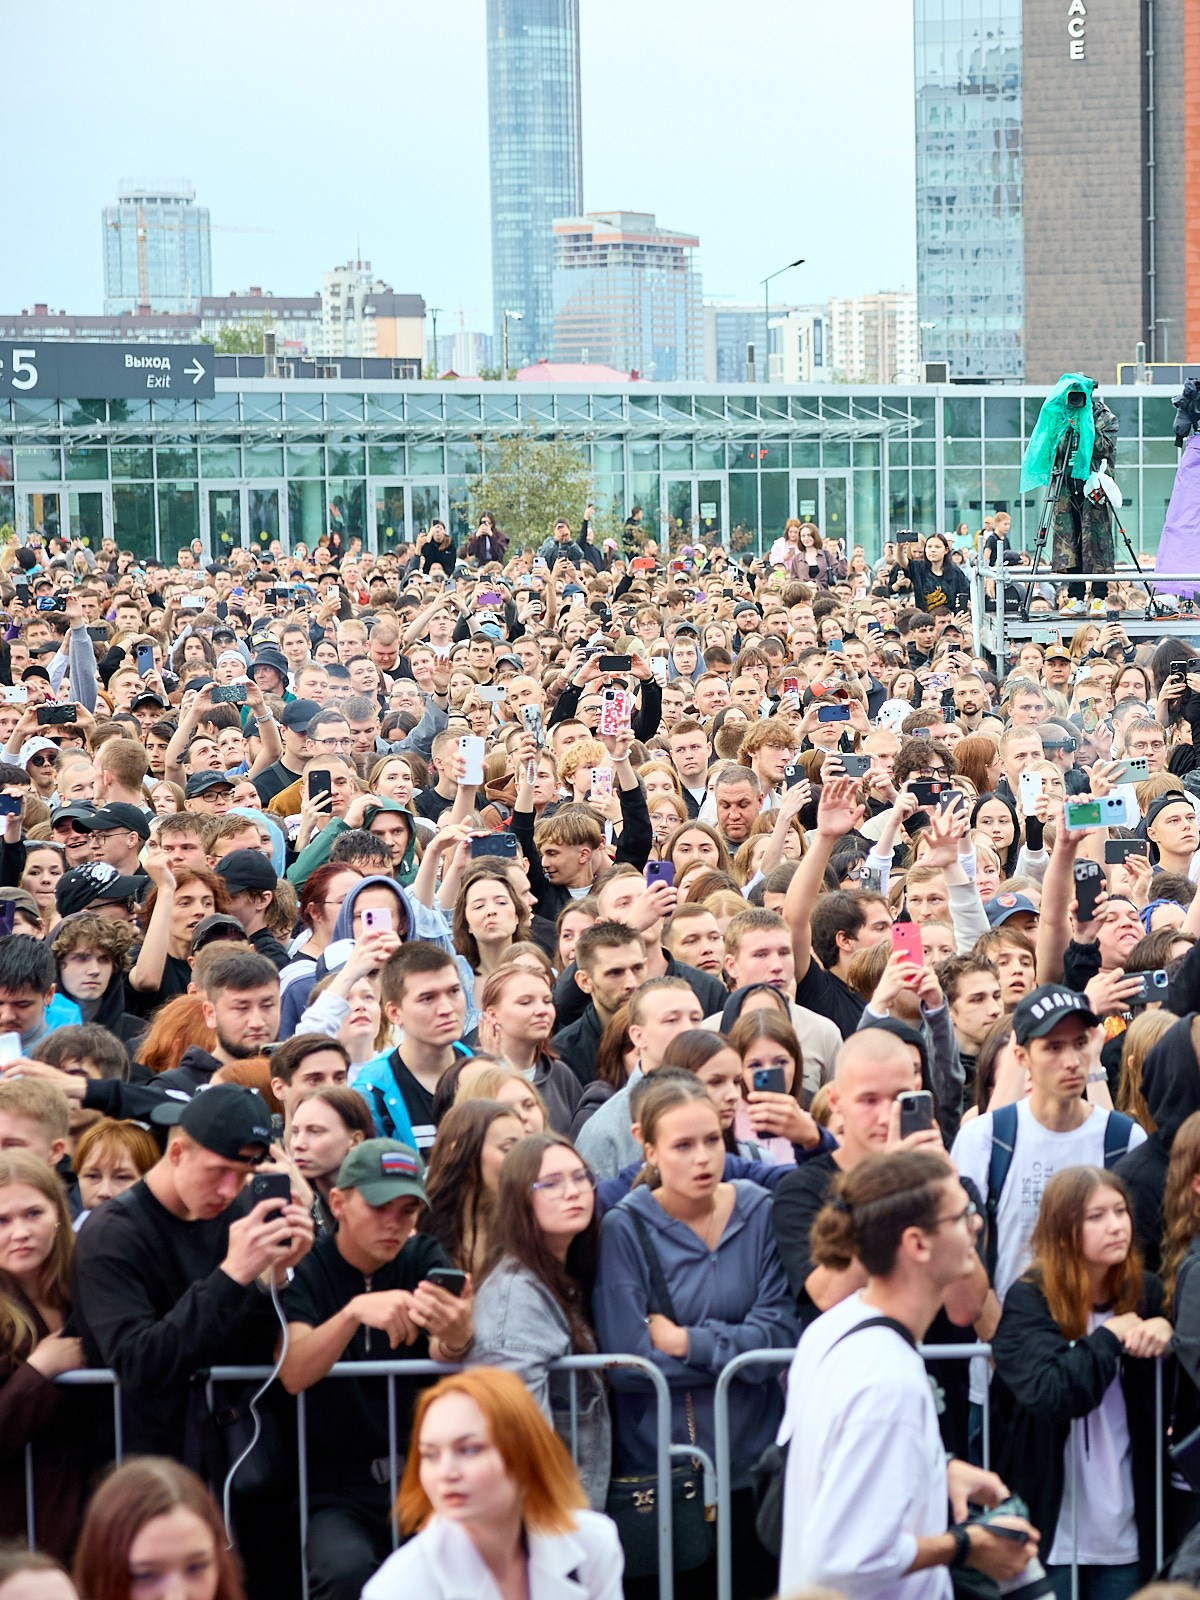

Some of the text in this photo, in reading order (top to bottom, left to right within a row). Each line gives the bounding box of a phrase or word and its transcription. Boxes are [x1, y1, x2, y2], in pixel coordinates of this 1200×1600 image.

[12, 349, 38, 390] 5
[125, 354, 171, 371] Выход
[146, 374, 171, 388] Exit
